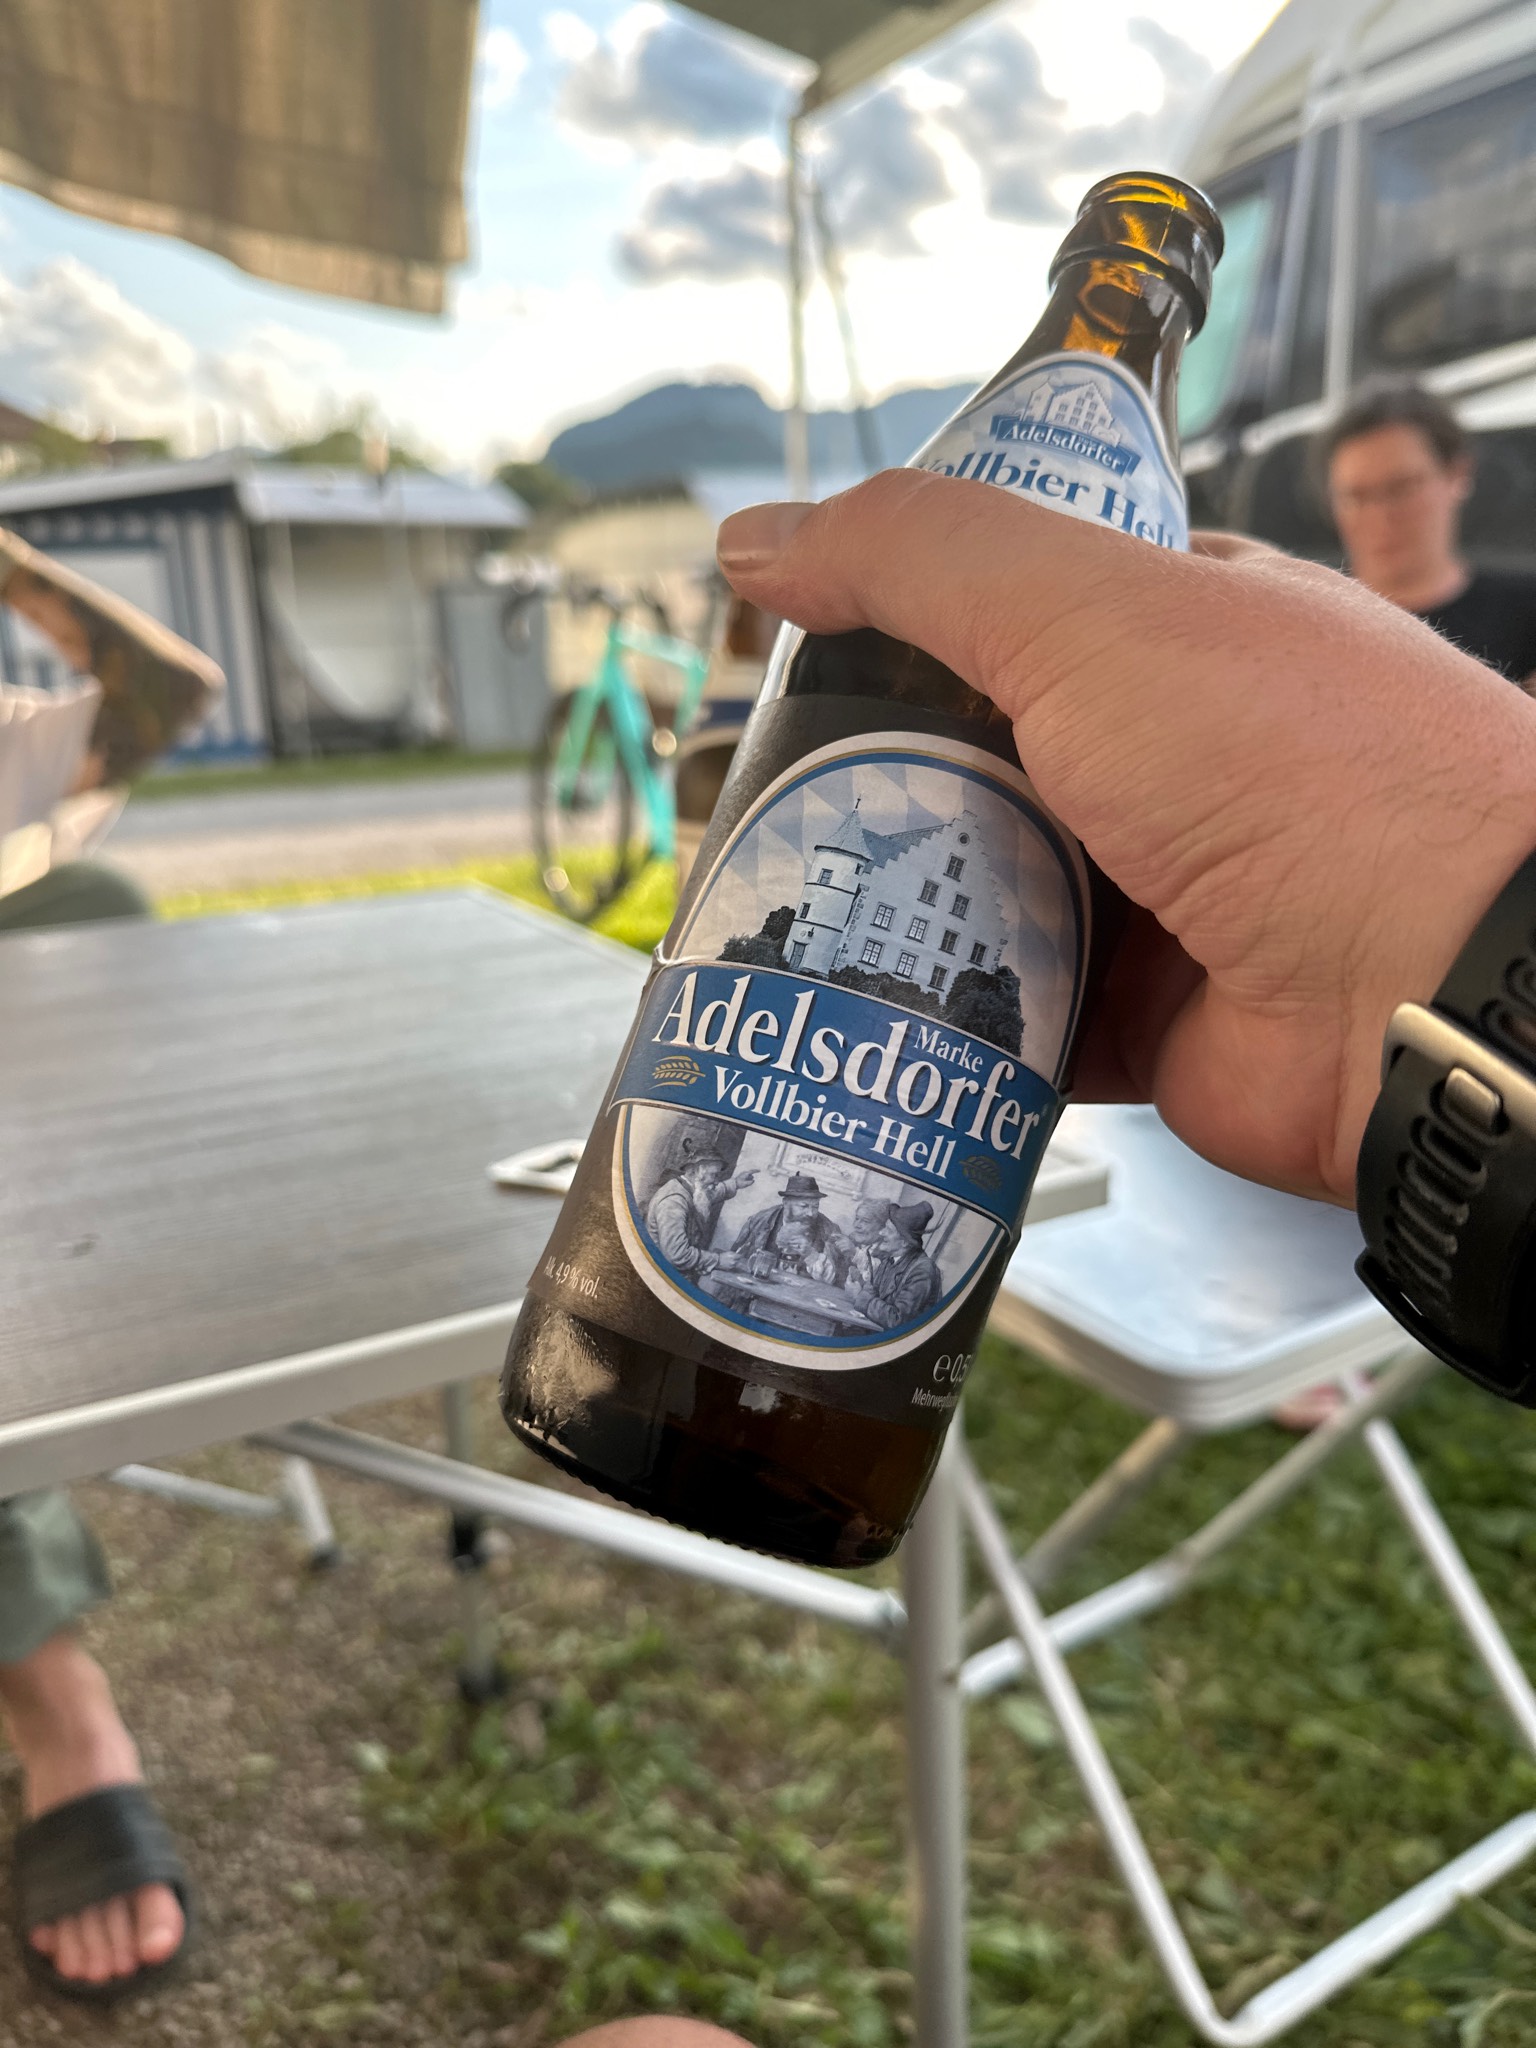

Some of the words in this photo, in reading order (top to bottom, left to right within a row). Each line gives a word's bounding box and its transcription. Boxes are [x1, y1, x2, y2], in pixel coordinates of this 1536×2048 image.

[1001, 424, 1122, 470] Adelsdorfer
[652, 972, 1040, 1160] Adelsdorfer
[915, 1024, 984, 1074] Marke
[713, 1065, 867, 1144] Vollbier
[870, 1116, 957, 1179] Hell
[580, 1276, 600, 1299] vol.
